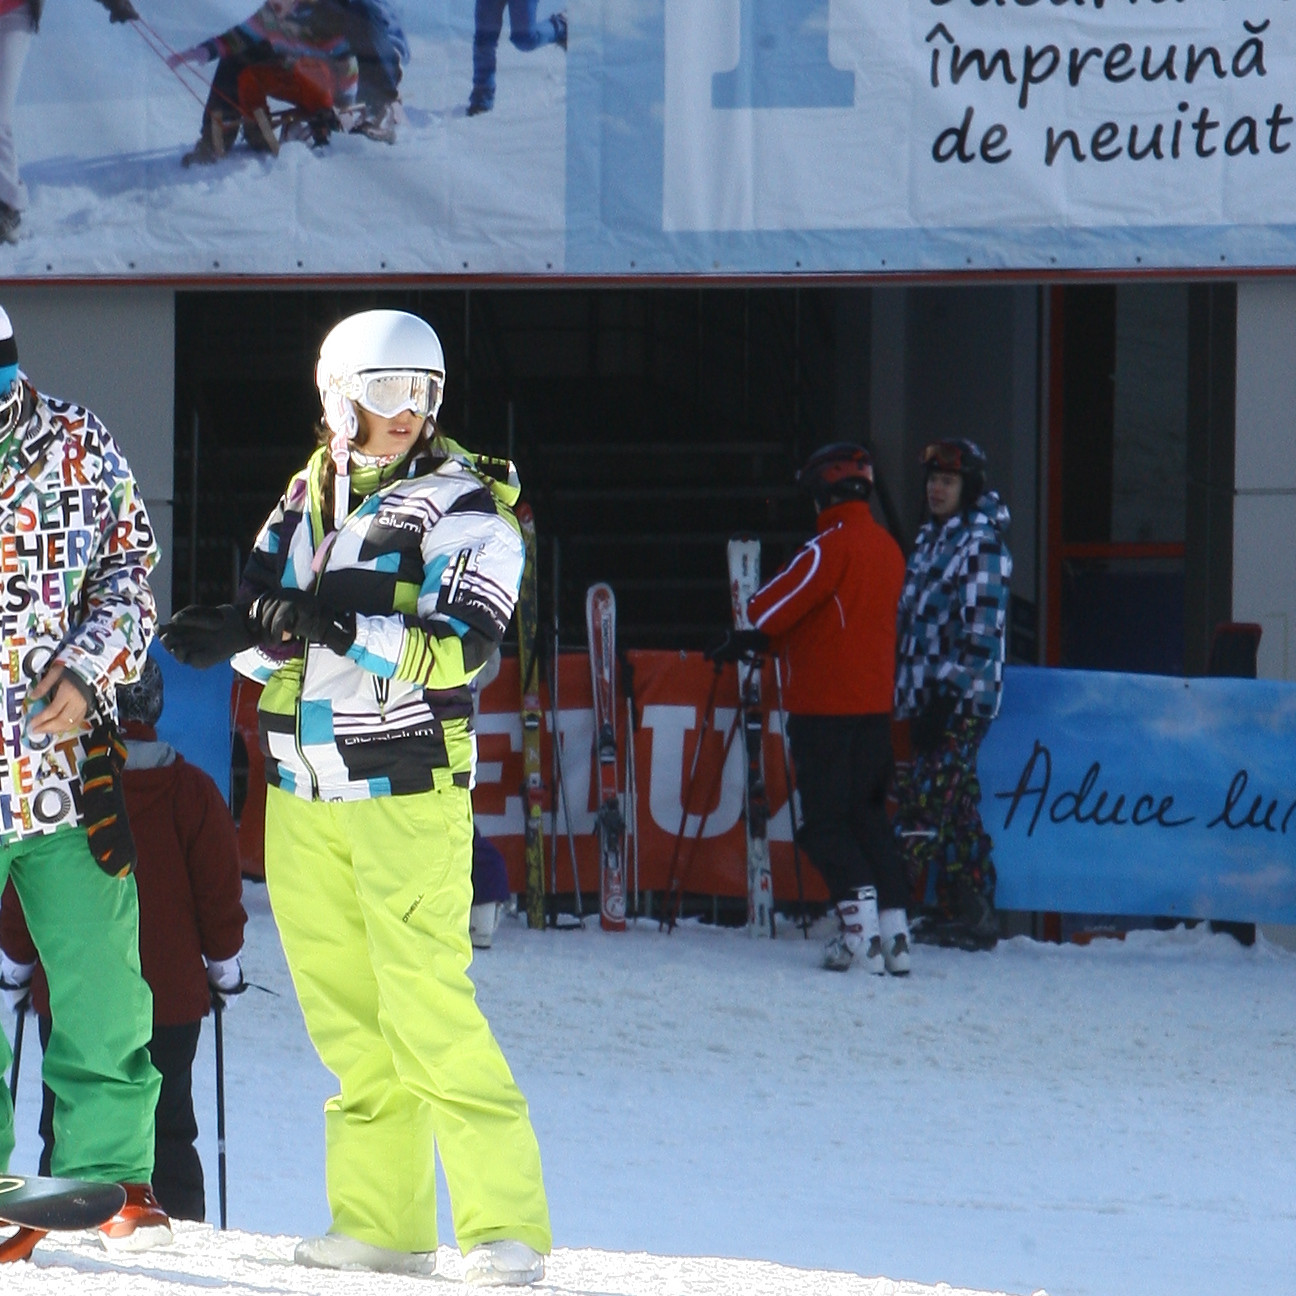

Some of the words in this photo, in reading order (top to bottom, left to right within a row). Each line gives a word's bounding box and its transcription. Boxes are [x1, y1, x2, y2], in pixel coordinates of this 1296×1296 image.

[925, 20, 1267, 109] împreună
[931, 106, 1012, 164] de
[995, 739, 1195, 837] Aduce
